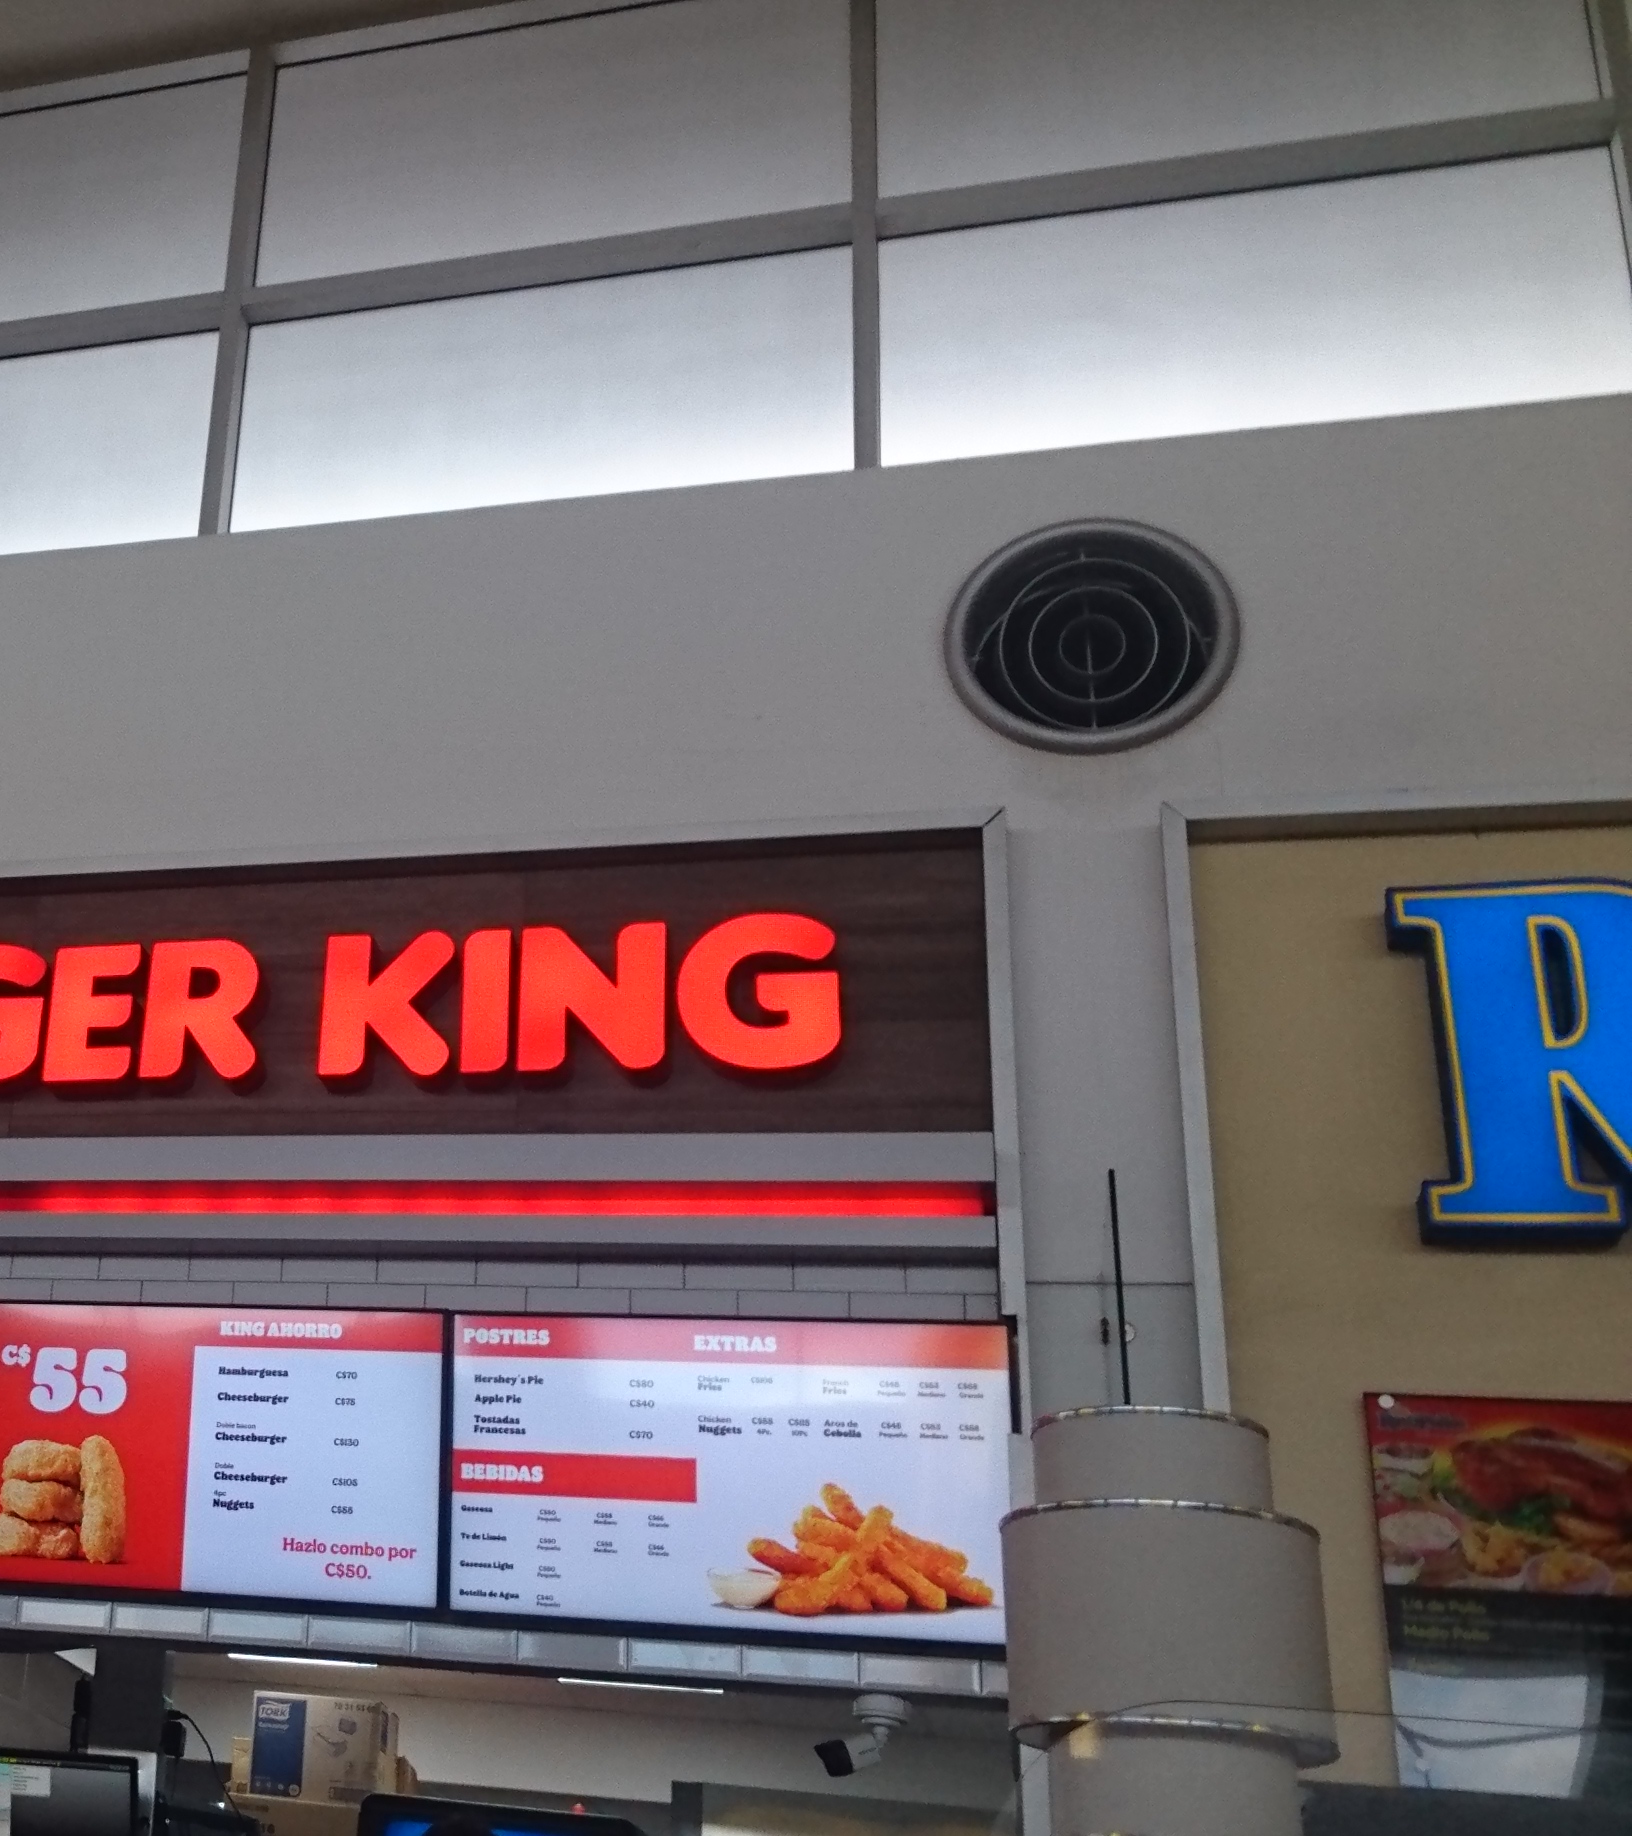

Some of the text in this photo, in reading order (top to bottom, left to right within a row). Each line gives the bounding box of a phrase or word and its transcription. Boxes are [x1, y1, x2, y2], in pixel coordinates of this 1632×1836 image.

[317, 912, 842, 1077] KING
[220, 1321, 343, 1339] KING AHORRO
[463, 1328, 550, 1345] POSTRES
[693, 1335, 777, 1352] EXTRAS
[218, 1366, 289, 1379] Hamburguesa
[335, 1371, 358, 1379] C$70
[527, 1376, 544, 1385] Pie
[697, 1375, 729, 1383] Chicken
[697, 1383, 722, 1391] Fries
[822, 1386, 847, 1395] Fries
[217, 1392, 289, 1405] Cheeseburger
[474, 1394, 522, 1404] Apple Pie
[629, 1399, 655, 1408] C$40
[473, 1415, 520, 1424] Tostadas
[697, 1415, 732, 1423] Chicken
[824, 1419, 858, 1428] Aros de
[473, 1425, 526, 1435] Francesas
[629, 1431, 653, 1439] C$70
[698, 1425, 742, 1436] Nuggets
[823, 1429, 862, 1438] Cebolla
[215, 1432, 287, 1445] Cheeseburger
[214, 1471, 288, 1485] Cheeseburger
[461, 1463, 544, 1483] BEBIDAS
[212, 1499, 254, 1511] Nuggets
[461, 1504, 493, 1513] Gaseosa
[471, 1533, 481, 1541] de
[282, 1537, 417, 1561] Hazlo combo por
[460, 1560, 514, 1571] Gaseosa Light
[325, 1562, 372, 1580] C$50.
[459, 1588, 519, 1600] Botella de Agua
